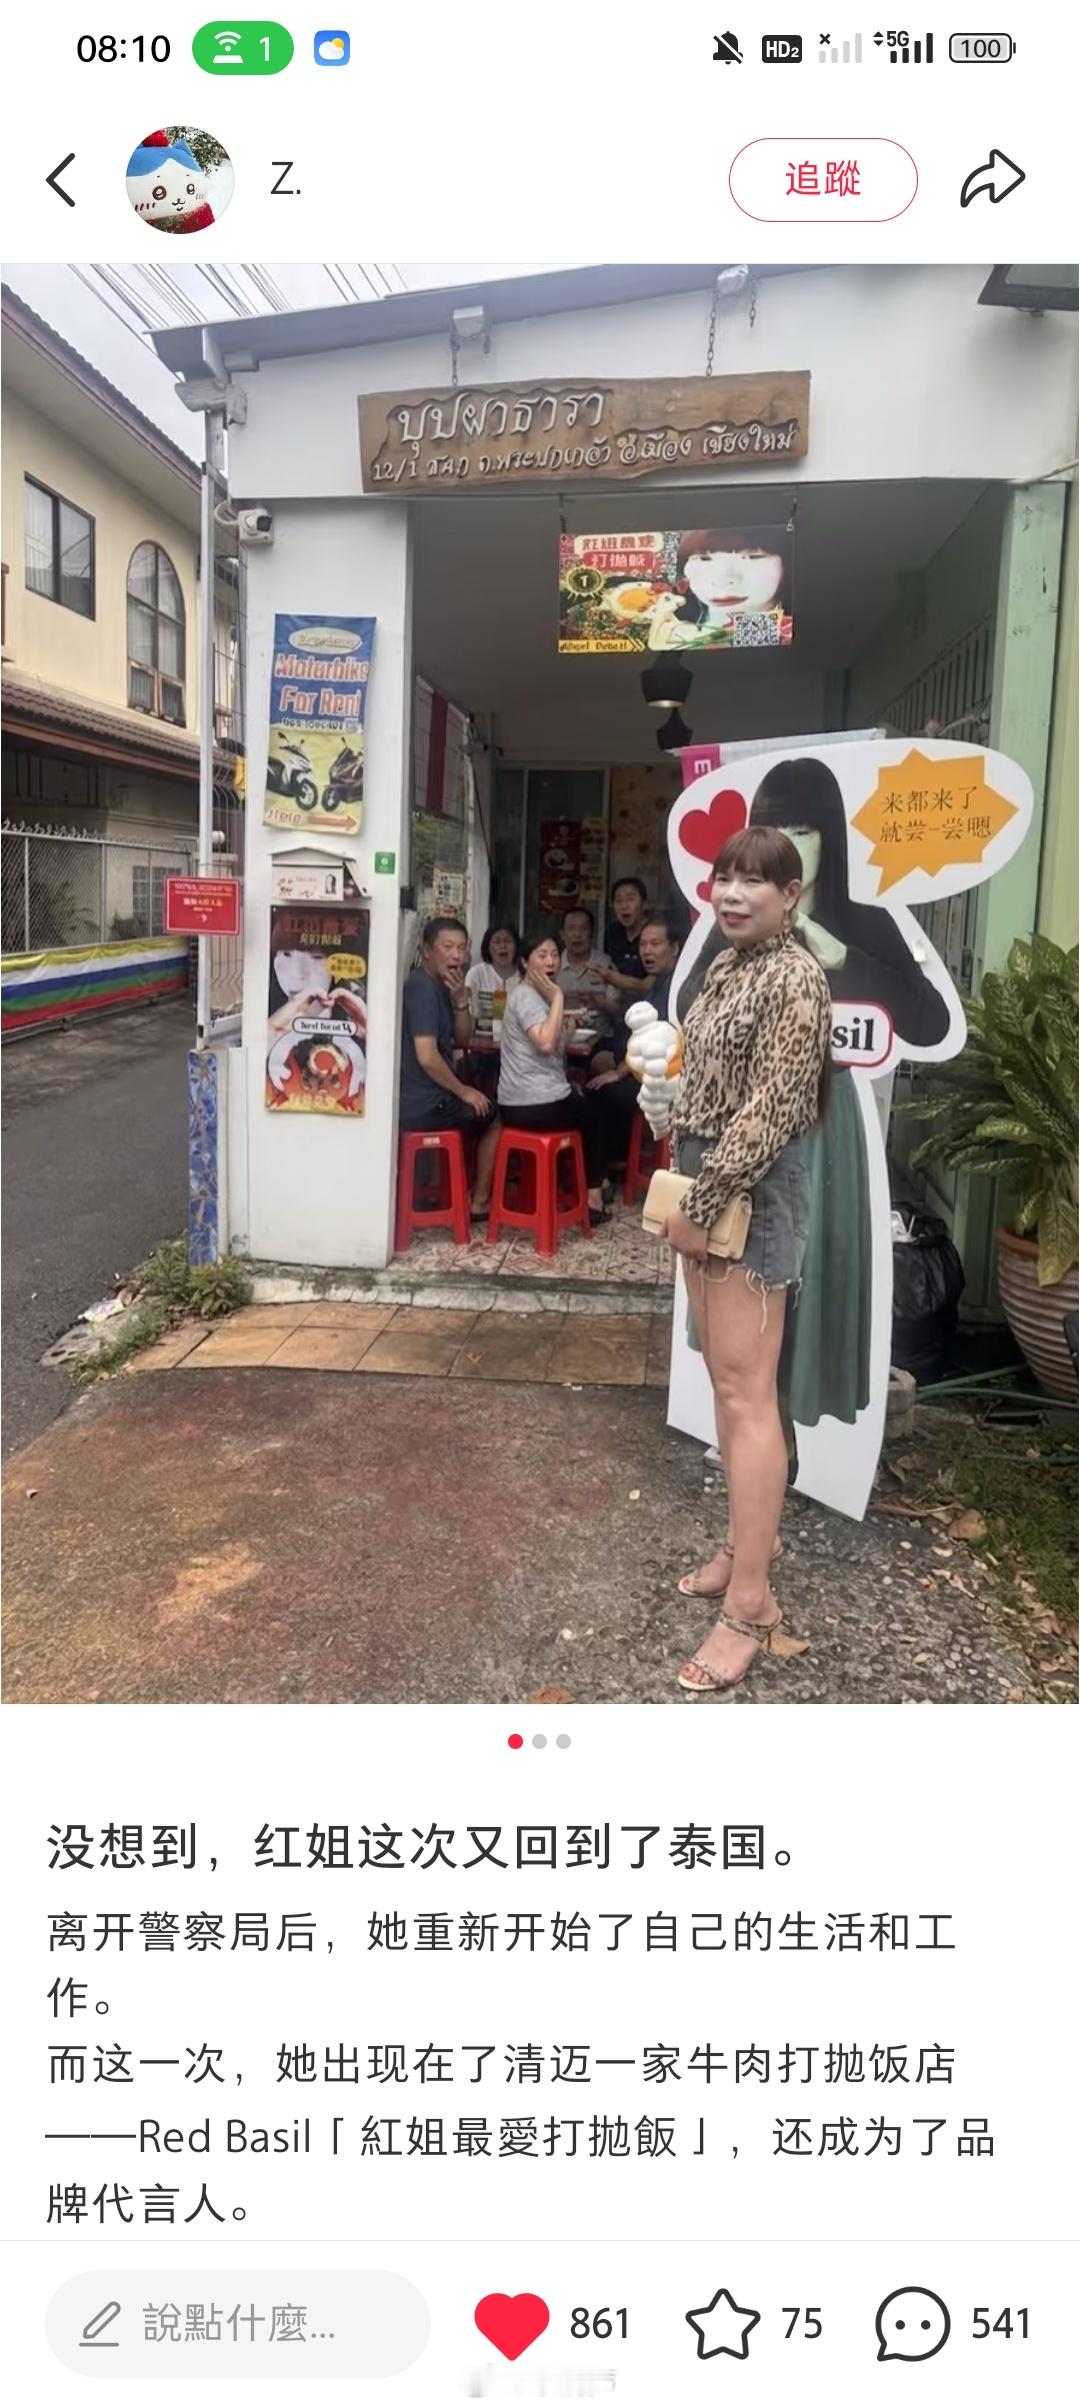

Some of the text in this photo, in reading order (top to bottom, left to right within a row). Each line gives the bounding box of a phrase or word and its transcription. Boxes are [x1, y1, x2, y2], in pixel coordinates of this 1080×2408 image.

[373, 458, 417, 483] 12/1
[274, 653, 369, 682] Motorbike
[279, 685, 361, 717] For Rent
[881, 785, 977, 815] 来都来了
